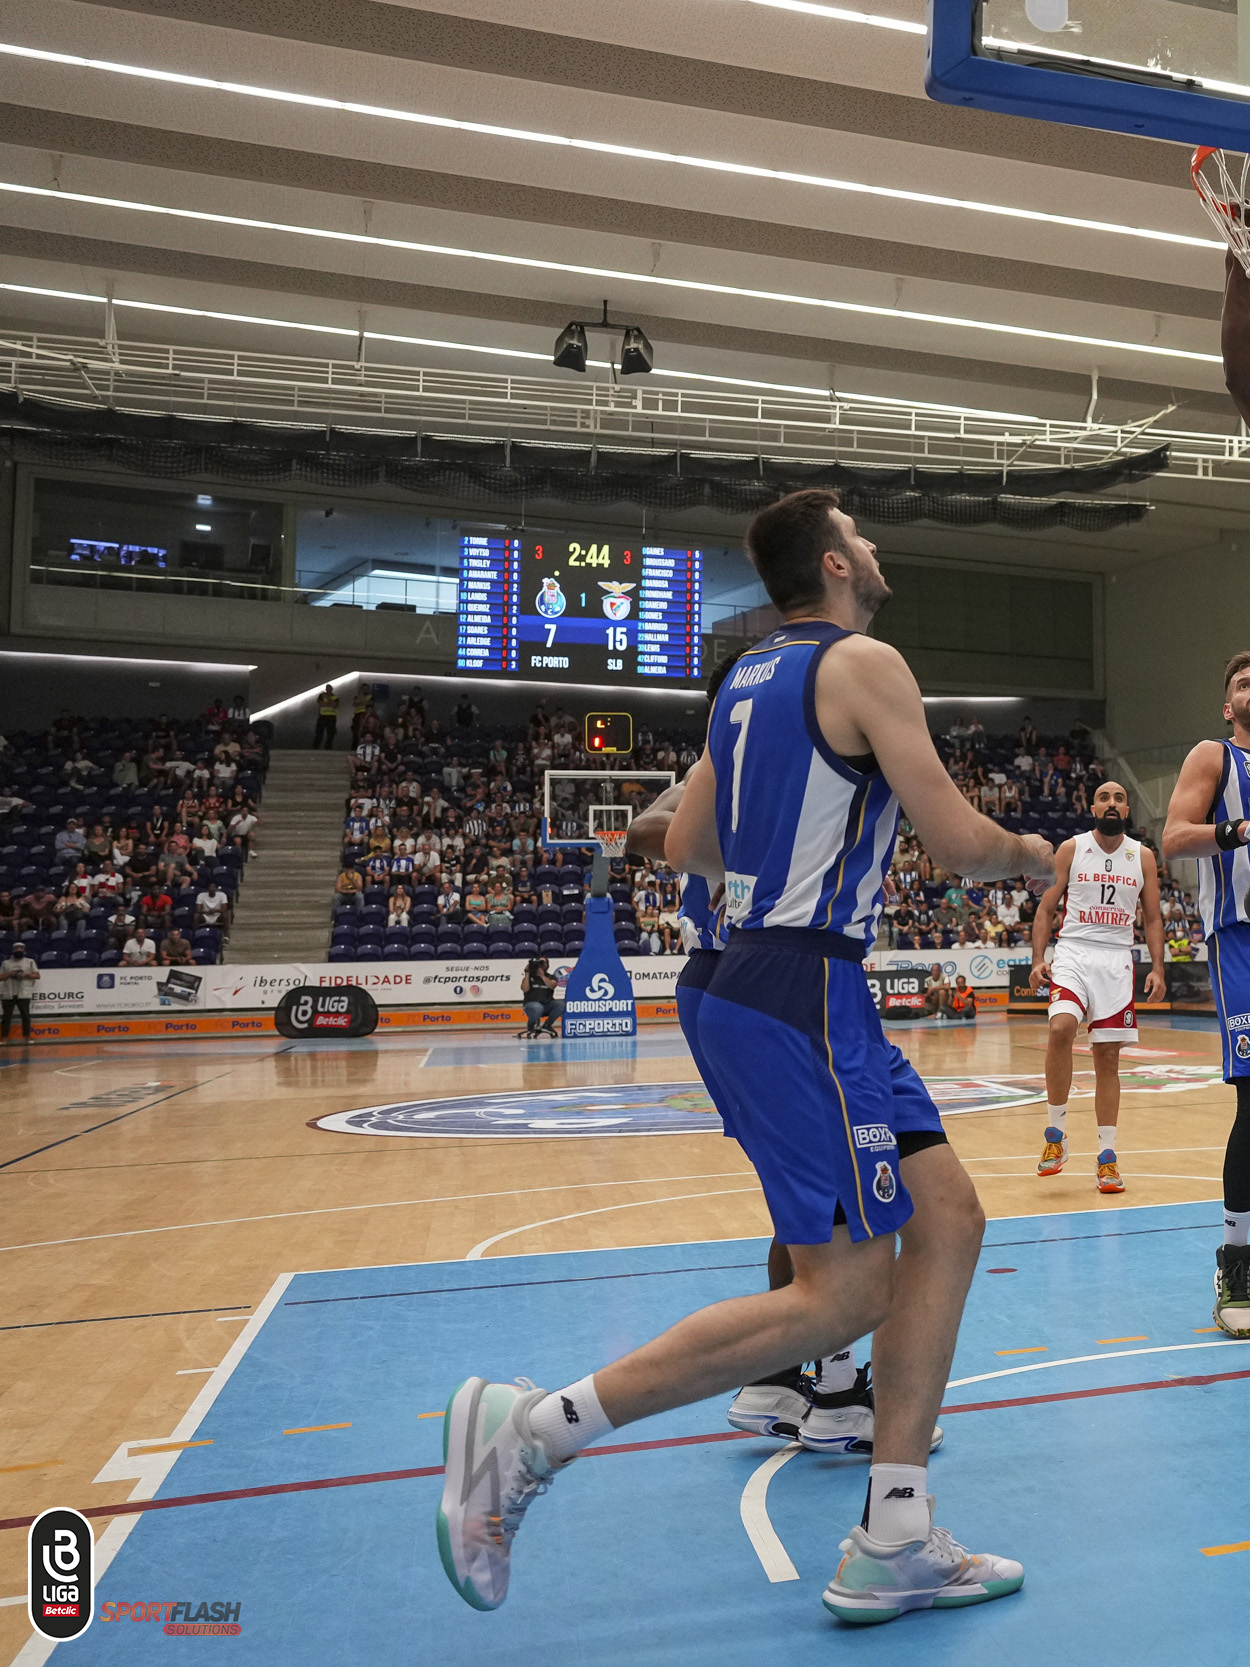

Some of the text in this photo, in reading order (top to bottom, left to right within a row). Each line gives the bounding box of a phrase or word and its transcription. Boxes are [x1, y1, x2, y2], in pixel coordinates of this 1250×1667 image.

[470, 537, 488, 545] TORRIE
[535, 545, 543, 559] 3
[569, 543, 610, 568] 2:44
[624, 551, 631, 564] 3
[469, 559, 490, 567] TINSLEY
[514, 561, 518, 569] 0
[513, 572, 518, 580] 0
[694, 582, 699, 590] 0
[581, 593, 585, 607] 1
[694, 593, 699, 601] 0
[694, 603, 698, 611] 0
[467, 615, 491, 623] ALMEIDA
[512, 616, 516, 624] 0
[694, 614, 698, 622] 3
[467, 626, 488, 634] SOARES
[544, 624, 556, 647] 7
[606, 627, 627, 650] 15
[694, 635, 698, 643] 0
[467, 637, 491, 645] ARLEDGE
[511, 650, 516, 658] 0
[694, 646, 698, 654] 2
[531, 656, 569, 668] FC PORTO
[607, 659, 623, 670] SLB
[694, 657, 698, 665] 0
[644, 666, 666, 674] ALMEIDA
[729, 656, 781, 689] MARKUS
[1078, 874, 1137, 886] SL BENFICA
[1101, 884, 1116, 904] 12
[1080, 911, 1130, 926] RAMIREZ
[253, 975, 307, 988] ibersol
[319, 975, 412, 987] FIDELIDADE
[423, 974, 511, 985] @fcportosports
[889, 997, 922, 1006] Betclic
[566, 1000, 633, 1013] BORDISPORT
[316, 1016, 348, 1026] Betclic
[423, 1014, 451, 1022] Porto
[483, 1012, 511, 1021] Porto
[165, 1022, 197, 1031] Porto
[232, 1020, 263, 1028] Porto
[567, 1018, 632, 1035] FCPORTO
[97, 1025, 129, 1033] Porto
